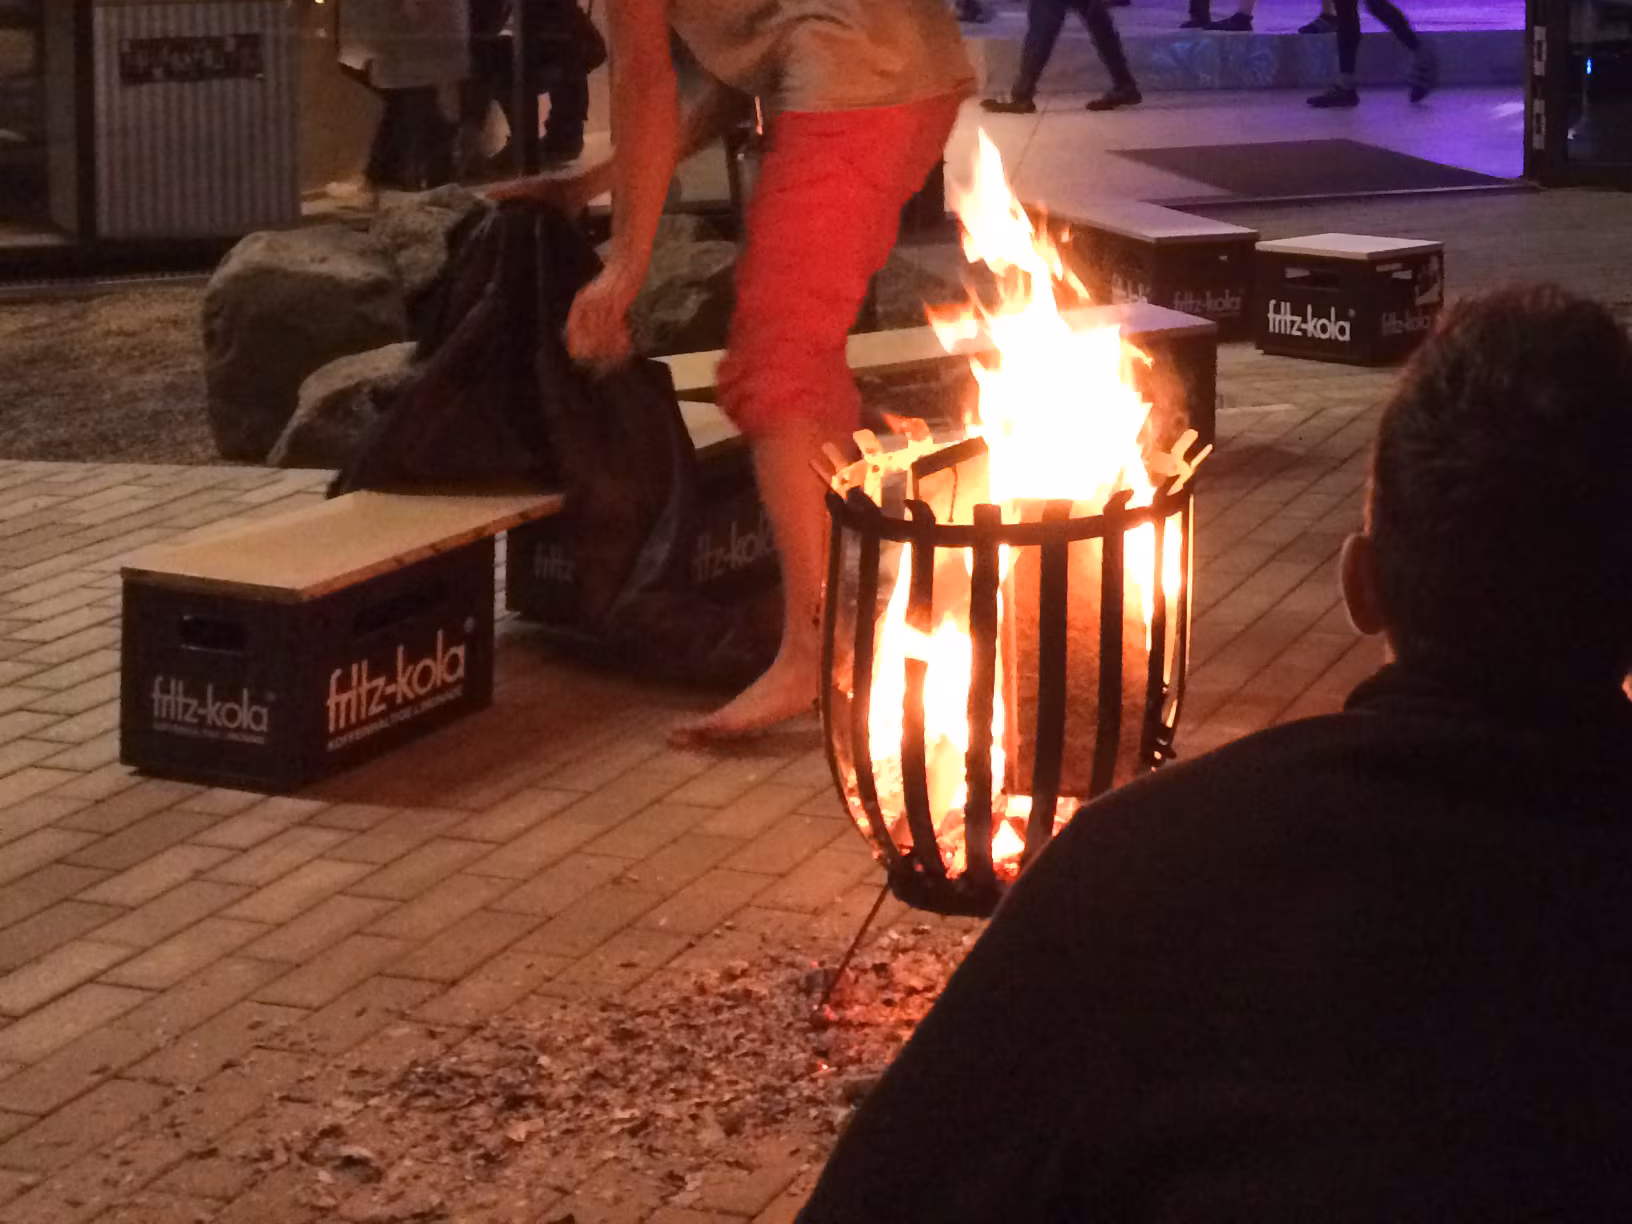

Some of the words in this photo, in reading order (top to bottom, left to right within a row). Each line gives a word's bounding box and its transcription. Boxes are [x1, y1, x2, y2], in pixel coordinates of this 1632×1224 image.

[1267, 299, 1351, 342] fritz-kola
[150, 674, 269, 733] fritz-kola
[326, 627, 466, 734] fritz-kola
